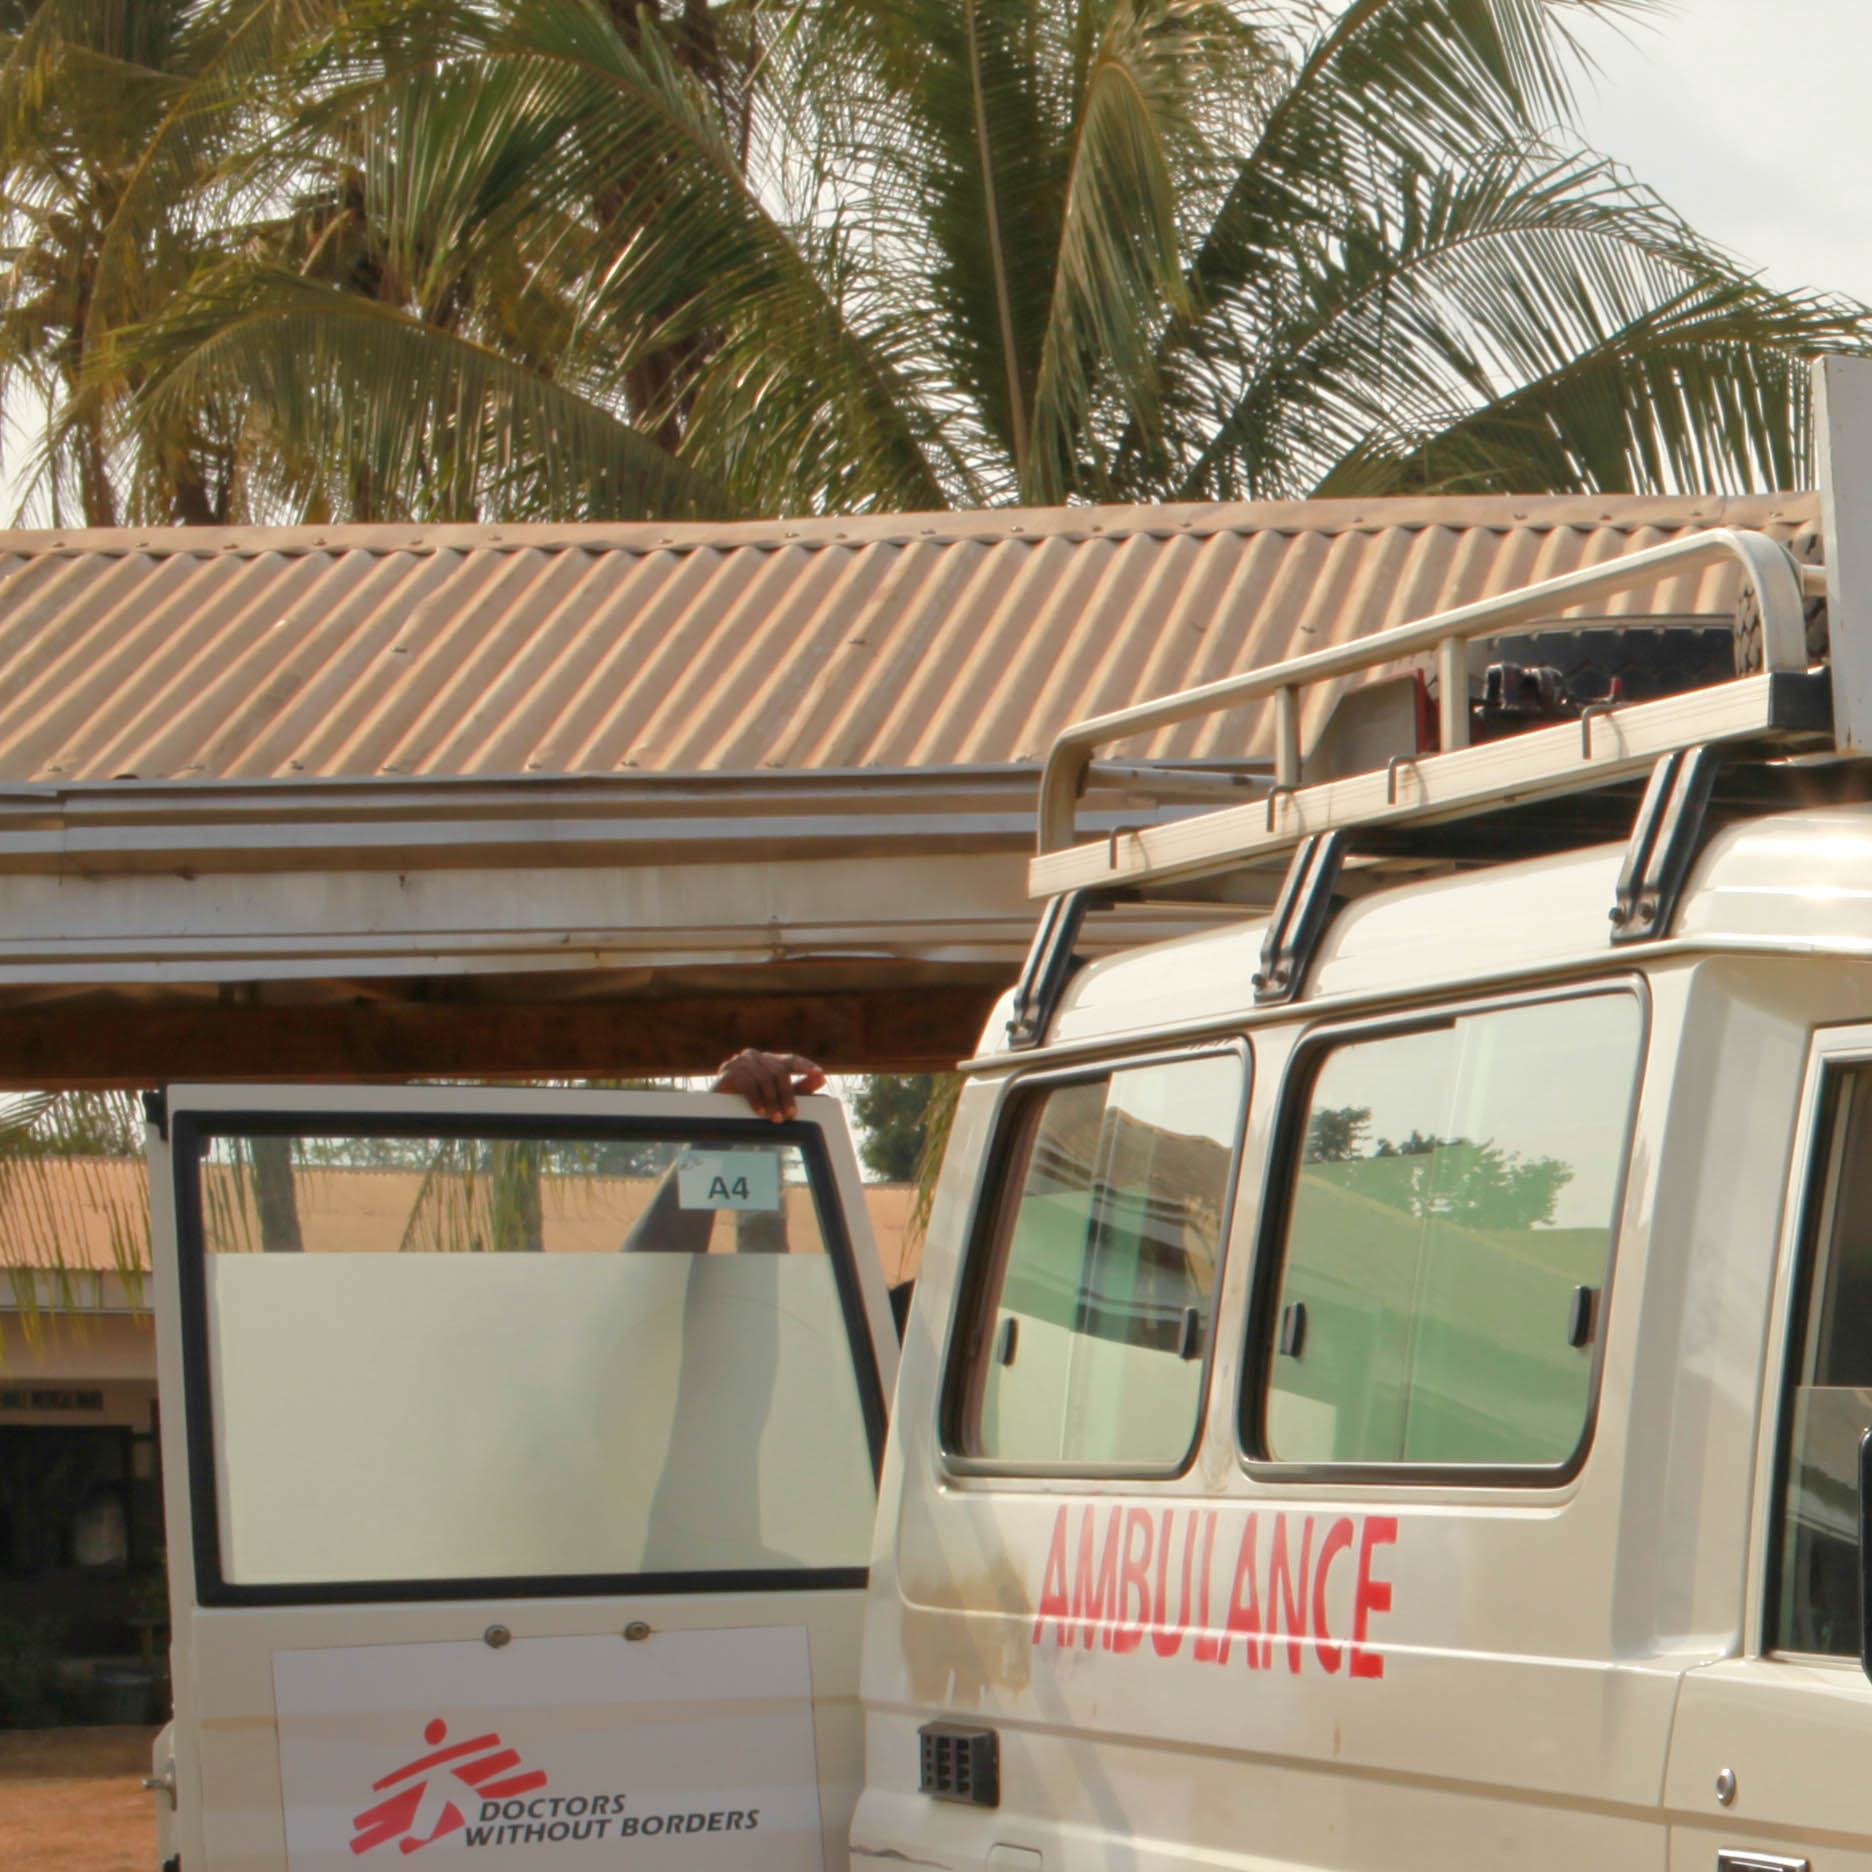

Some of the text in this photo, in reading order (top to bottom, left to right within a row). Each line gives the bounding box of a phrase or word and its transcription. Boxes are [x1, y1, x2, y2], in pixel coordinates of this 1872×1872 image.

[708, 1175, 750, 1200] A4
[1032, 1503, 1399, 1680] AMBULANCE
[479, 1794, 627, 1823] DOCTORS
[464, 1809, 760, 1848] WITHOUT BORDERS
